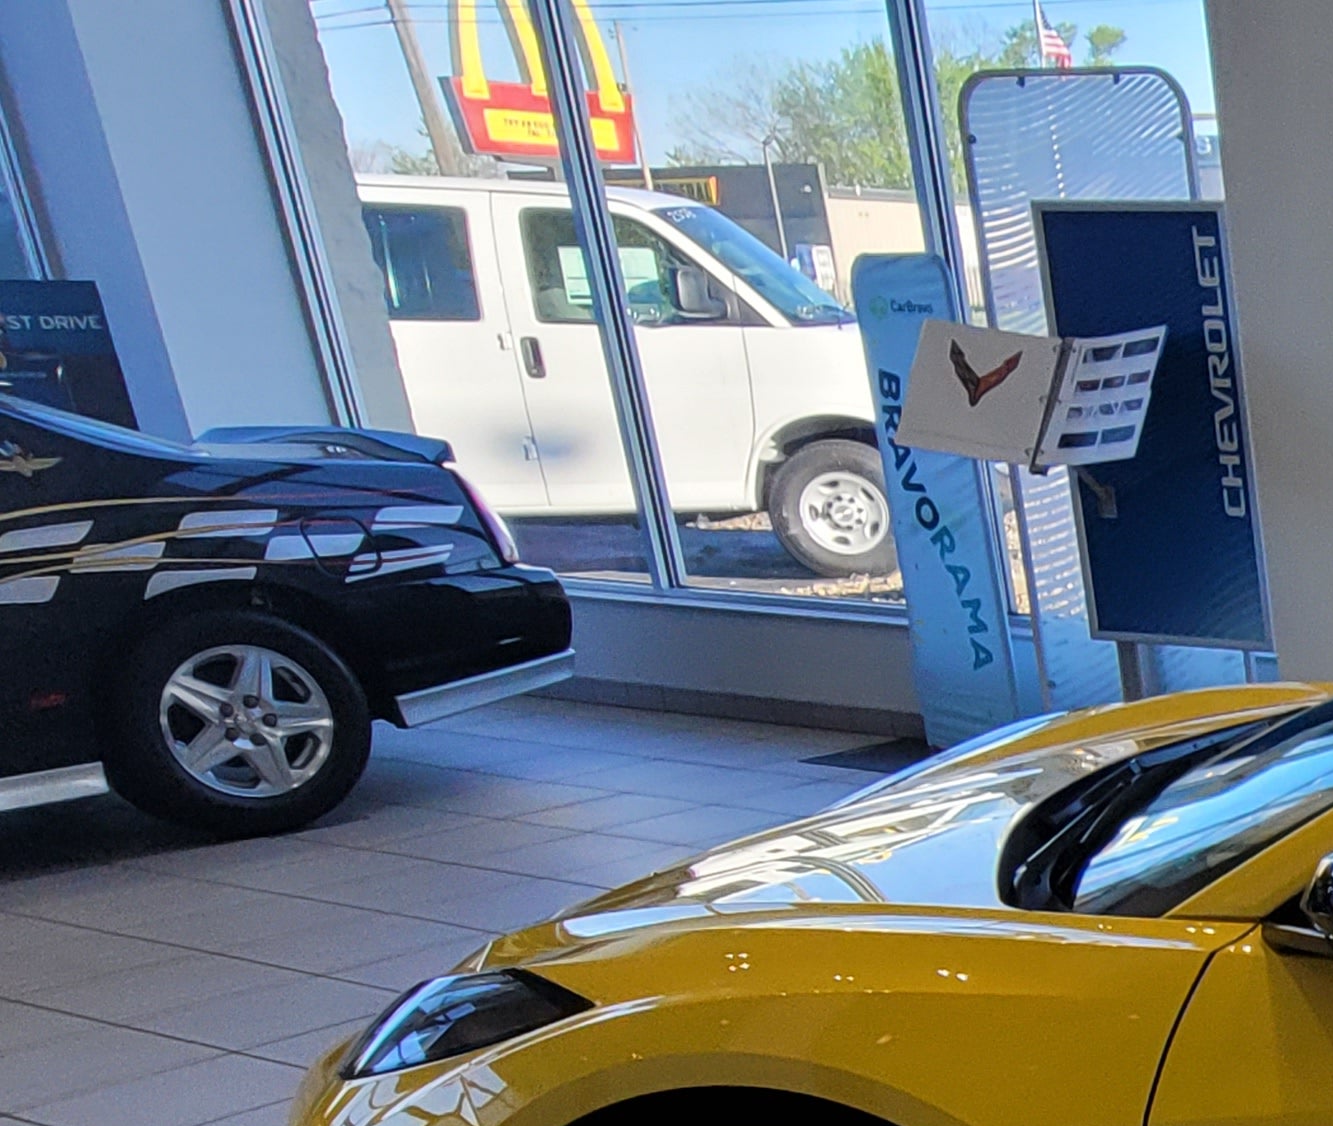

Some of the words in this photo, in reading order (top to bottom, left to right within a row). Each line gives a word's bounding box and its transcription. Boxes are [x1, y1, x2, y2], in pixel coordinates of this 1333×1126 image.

[6, 314, 32, 331] ST
[39, 314, 103, 331] DRIVE
[1192, 225, 1246, 518] CHEVROLET
[878, 368, 993, 671] BRAVORAMA
